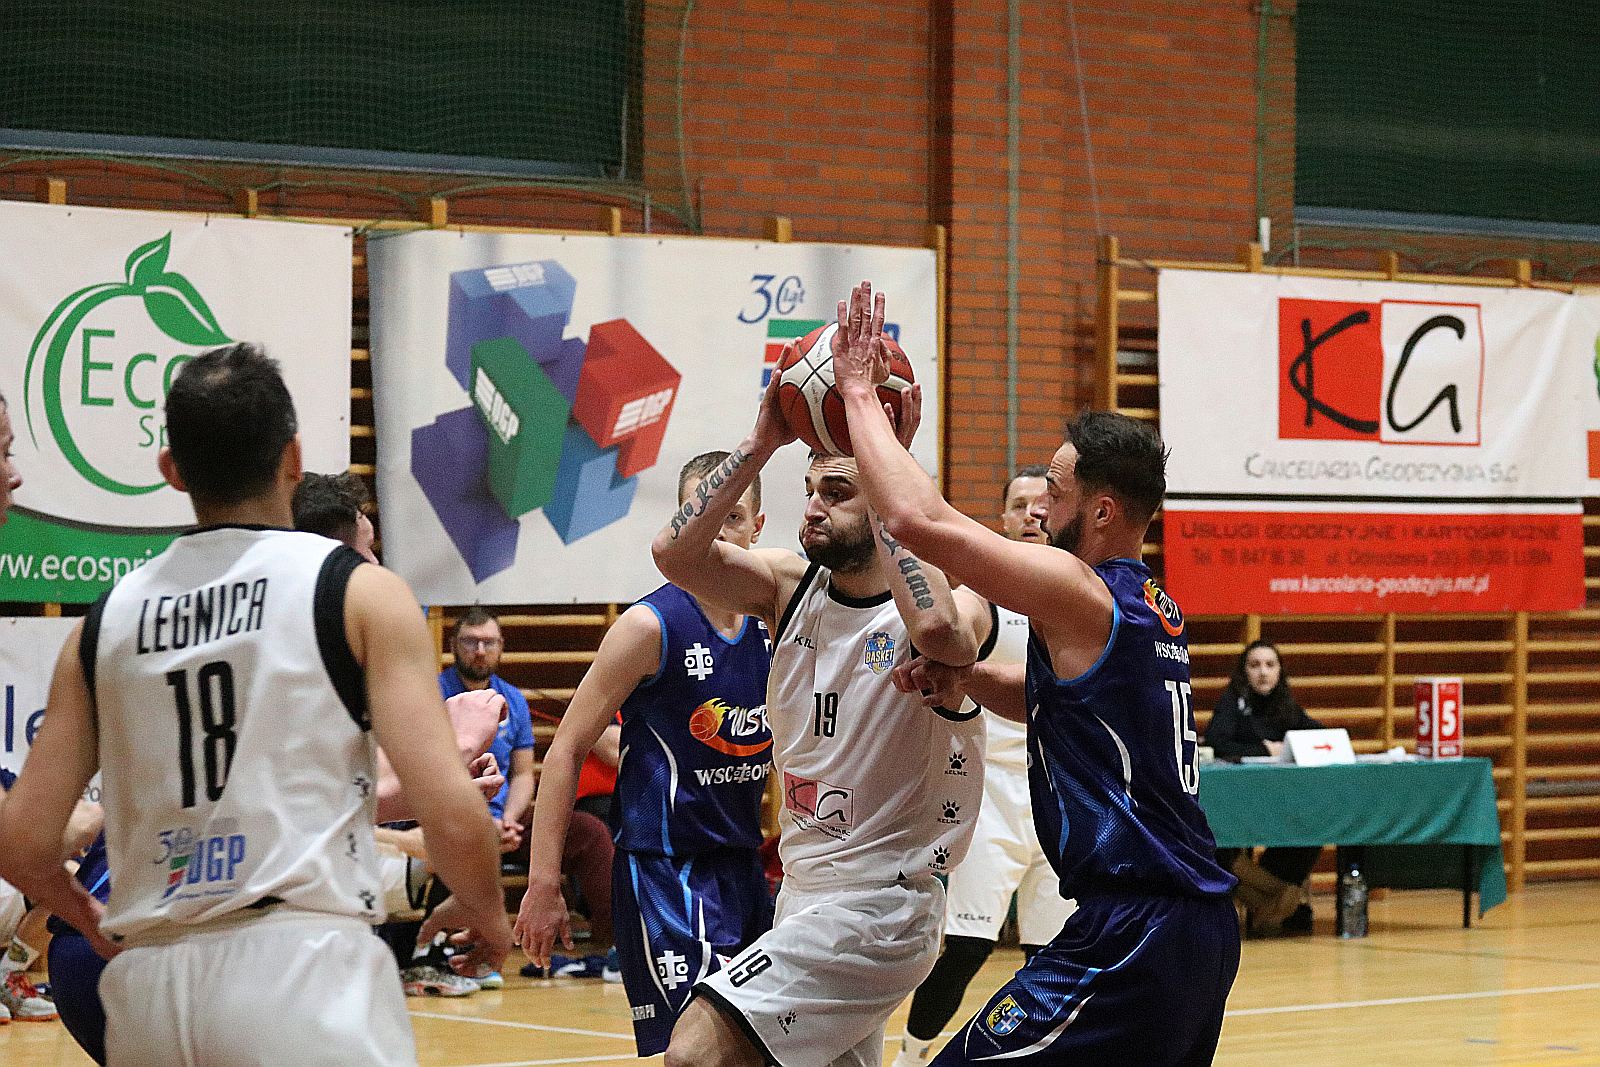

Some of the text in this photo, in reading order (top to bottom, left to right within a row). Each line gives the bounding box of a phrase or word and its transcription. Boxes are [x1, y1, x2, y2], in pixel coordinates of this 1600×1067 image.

[136, 577, 268, 655] LEGNICA
[866, 649, 895, 664] BASKET
[814, 691, 839, 738] 19
[1417, 700, 1431, 736] 5
[1441, 700, 1457, 736] 5
[165, 661, 238, 809] 18
[1164, 679, 1200, 795] 15
[944, 768, 968, 777] KELME
[937, 817, 961, 825] KELME
[956, 912, 993, 923] KELME
[727, 948, 773, 988] 19
